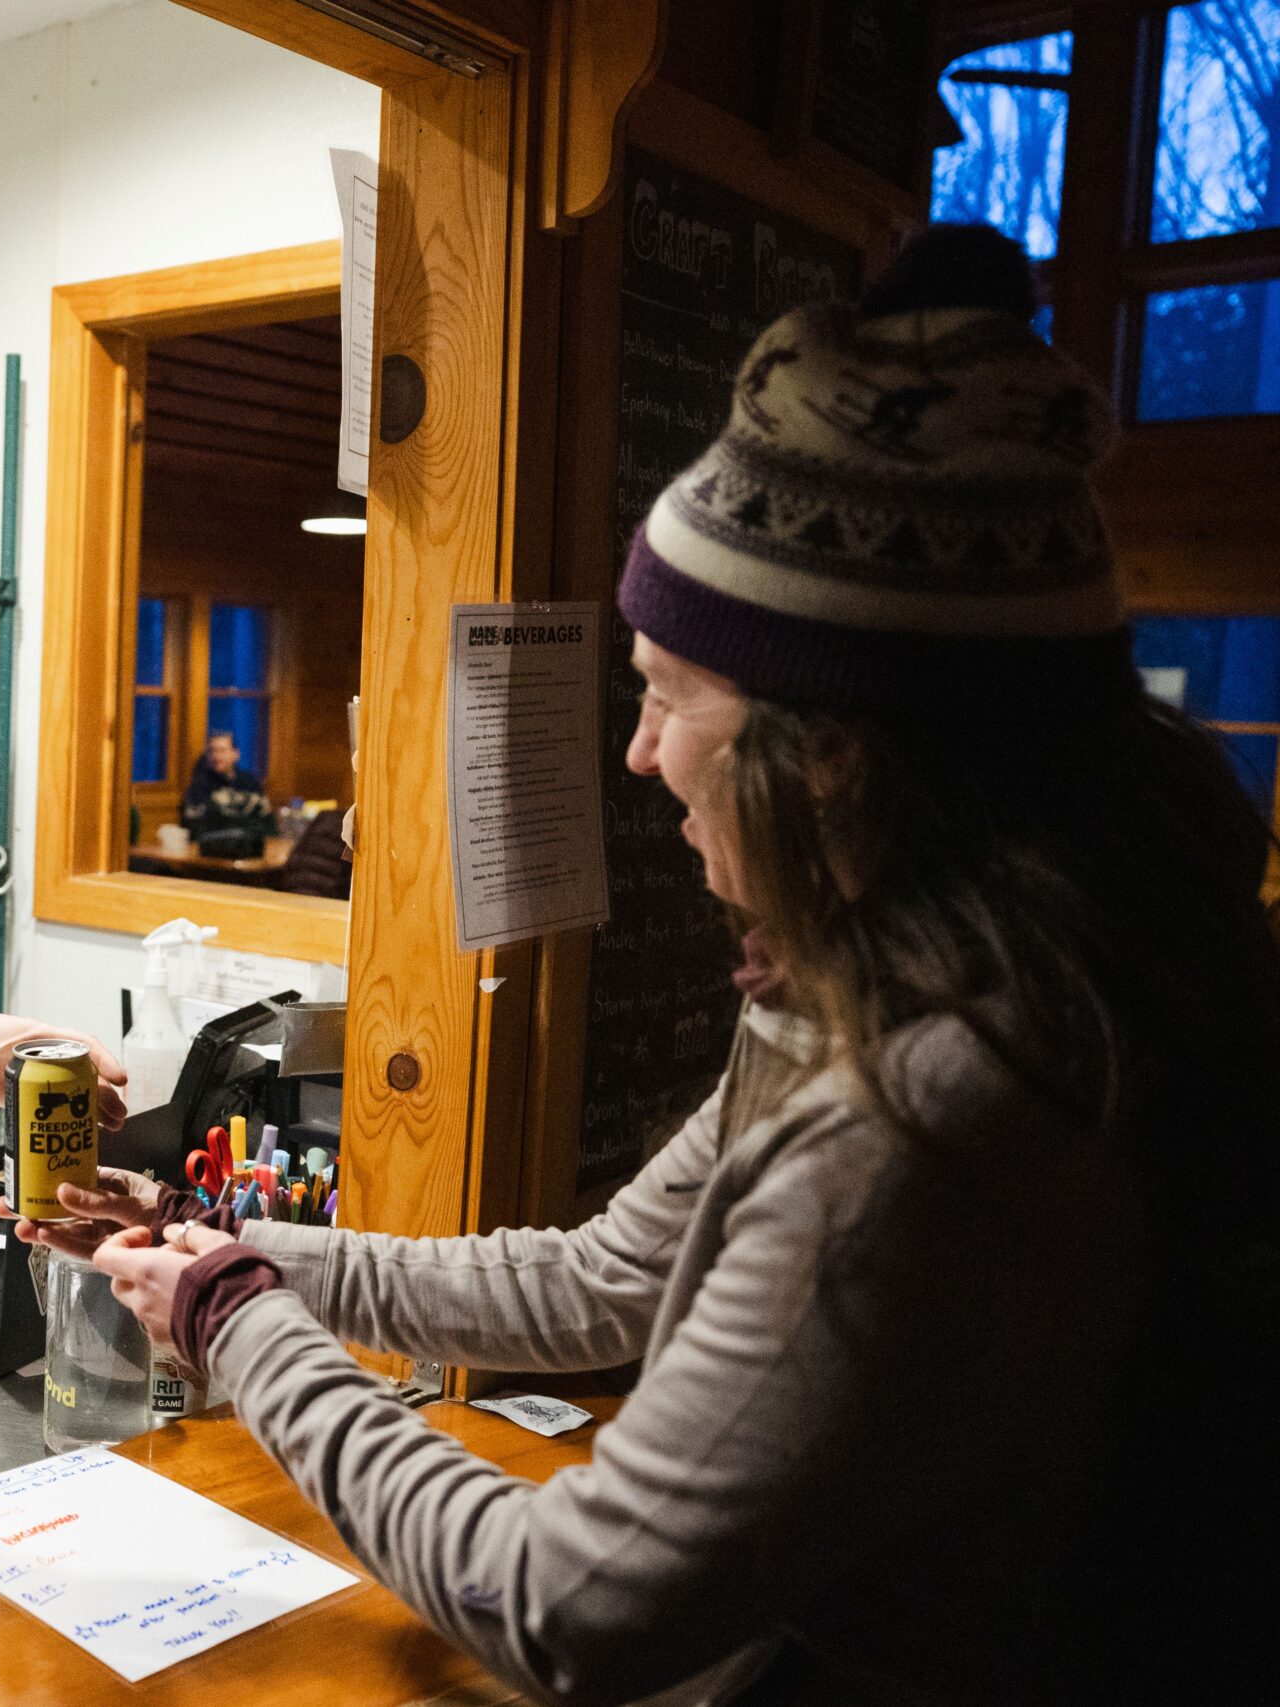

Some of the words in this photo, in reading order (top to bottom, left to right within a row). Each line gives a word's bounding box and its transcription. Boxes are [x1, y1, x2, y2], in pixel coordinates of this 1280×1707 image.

[631, 178, 733, 290] CRAFT
[504, 625, 583, 646] BEVERAGES
[30, 1129, 94, 1154] EDGE
[47, 1155, 81, 1171] Cider
[157, 1400, 183, 1408] GAME
[61, 1471, 76, 1479] the
[79, 1459, 115, 1473] kitchen
[21, 1584, 58, 1604] 8:15
[93, 1611, 131, 1628] Please
[144, 1595, 176, 1611] make
[228, 1566, 253, 1579] clean
[140, 1614, 166, 1629] after
